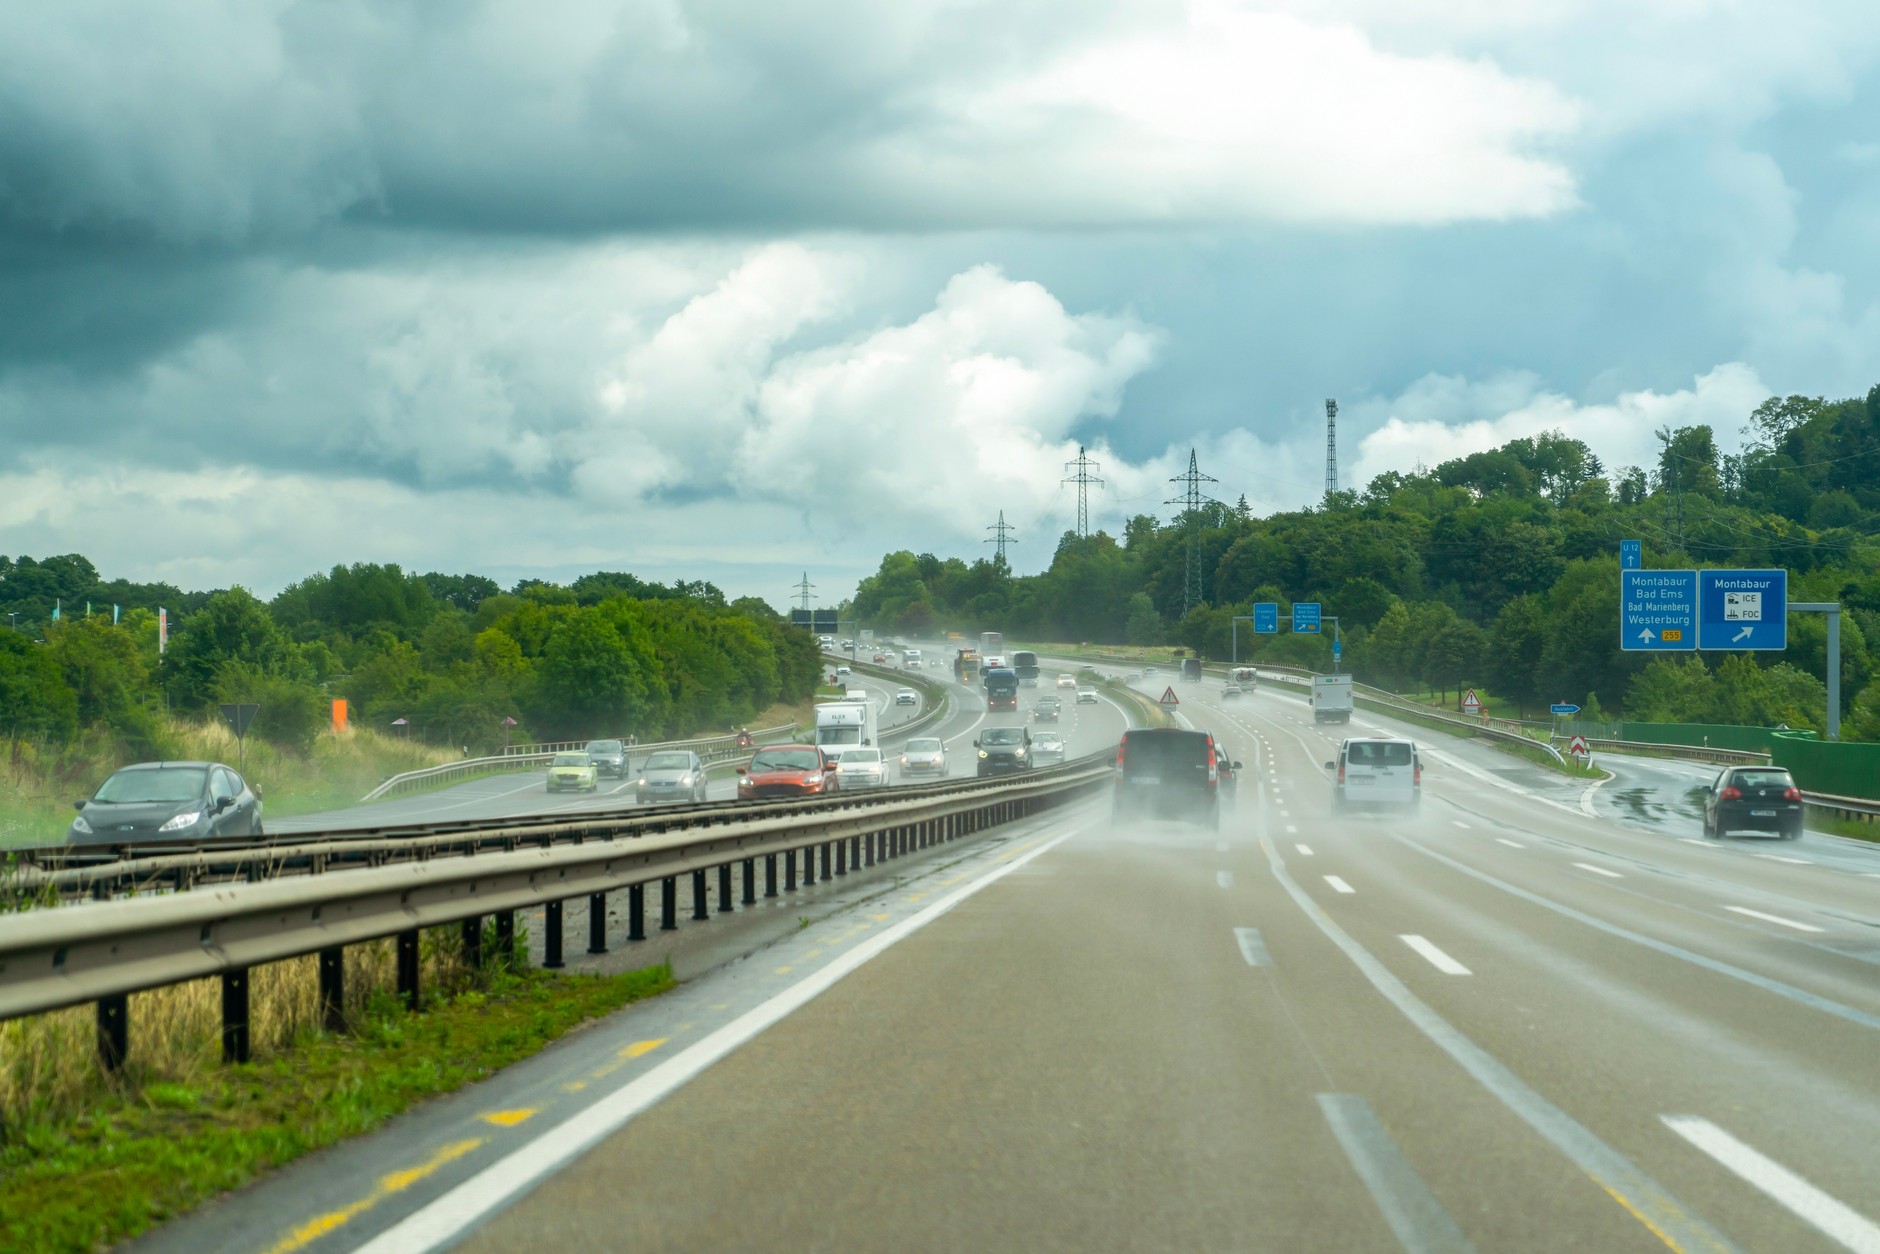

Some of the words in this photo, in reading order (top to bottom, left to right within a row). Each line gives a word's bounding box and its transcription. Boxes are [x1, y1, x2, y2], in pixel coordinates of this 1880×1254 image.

[1631, 577, 1687, 586] Montabaur
[1714, 579, 1771, 588] Montabaur
[1636, 589, 1656, 599] Bad
[1660, 589, 1683, 599] Ems
[1742, 594, 1757, 603] ICE
[1628, 602, 1643, 611] Bad
[1645, 602, 1690, 613] Marienberg
[1742, 610, 1759, 618] FOC
[1628, 615, 1690, 626] Westerburg
